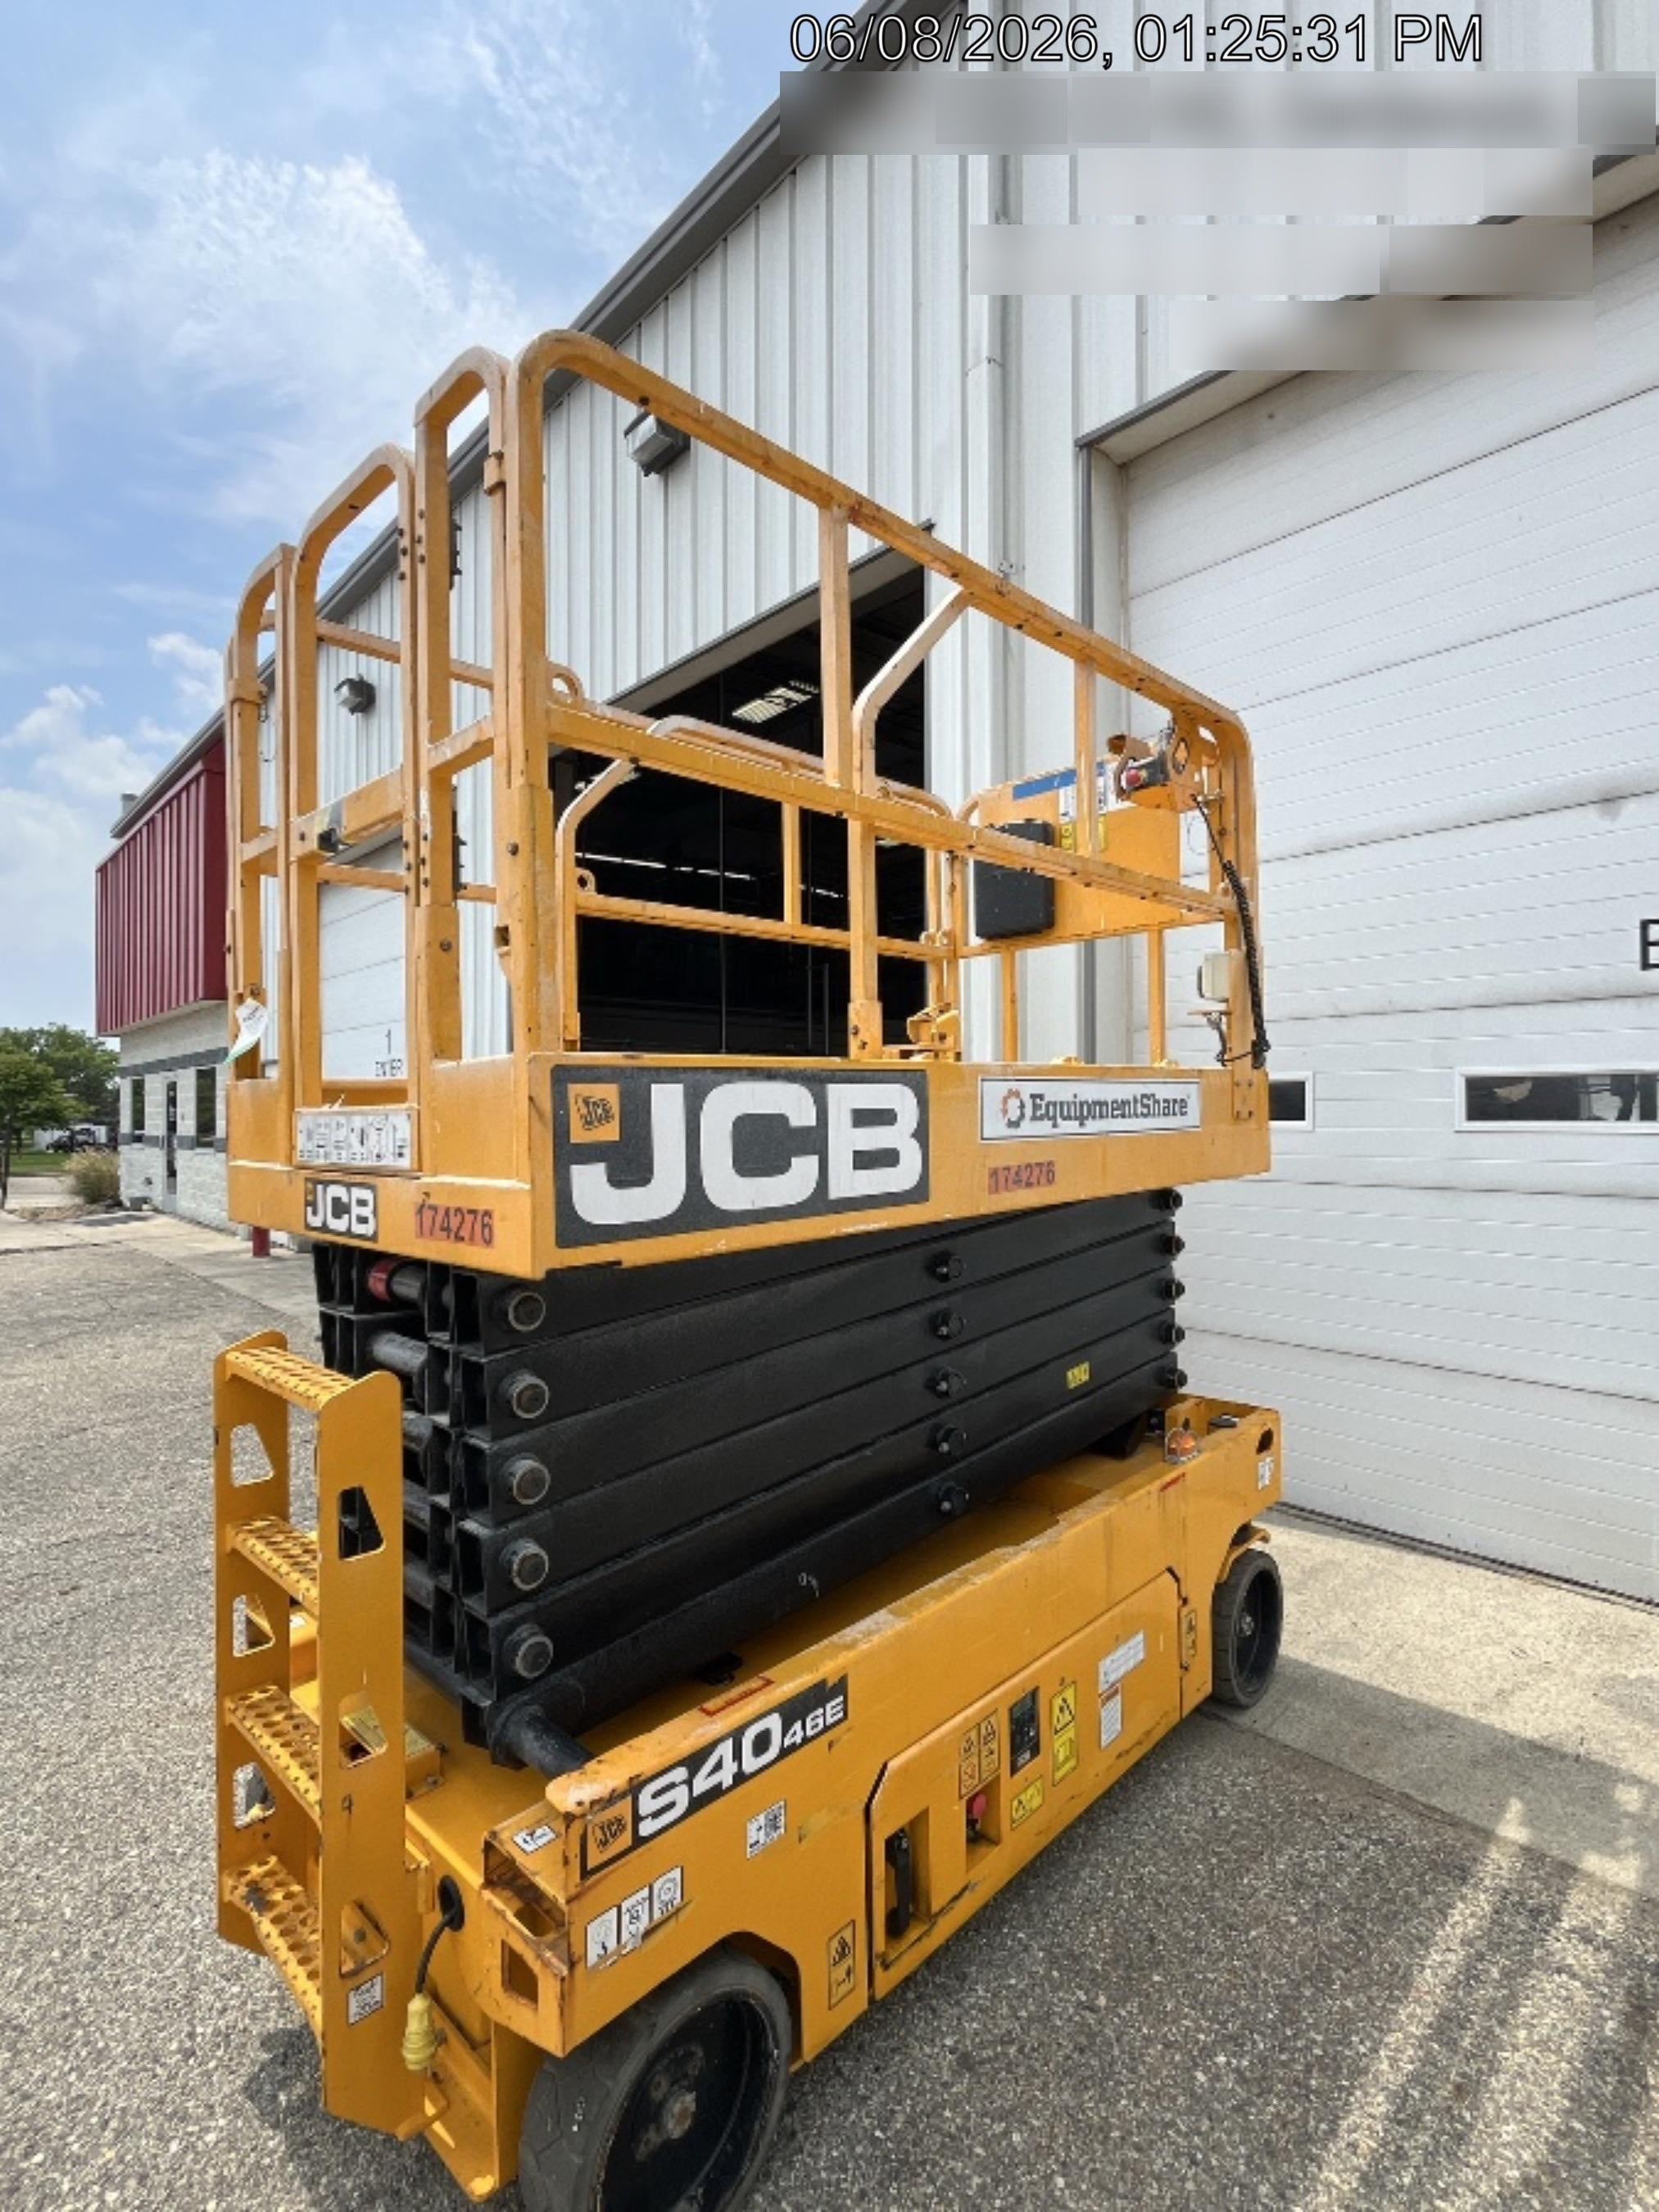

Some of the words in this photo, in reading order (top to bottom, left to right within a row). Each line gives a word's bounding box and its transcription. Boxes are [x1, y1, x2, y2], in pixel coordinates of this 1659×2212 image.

[385, 1029, 392, 1054] 1
[1029, 1093, 1190, 1129] EquipmentShare
[569, 1081, 922, 1226] JCB
[989, 1160, 1056, 1190] 174276
[306, 1184, 377, 1237] JCB
[415, 1199, 493, 1247] 174276
